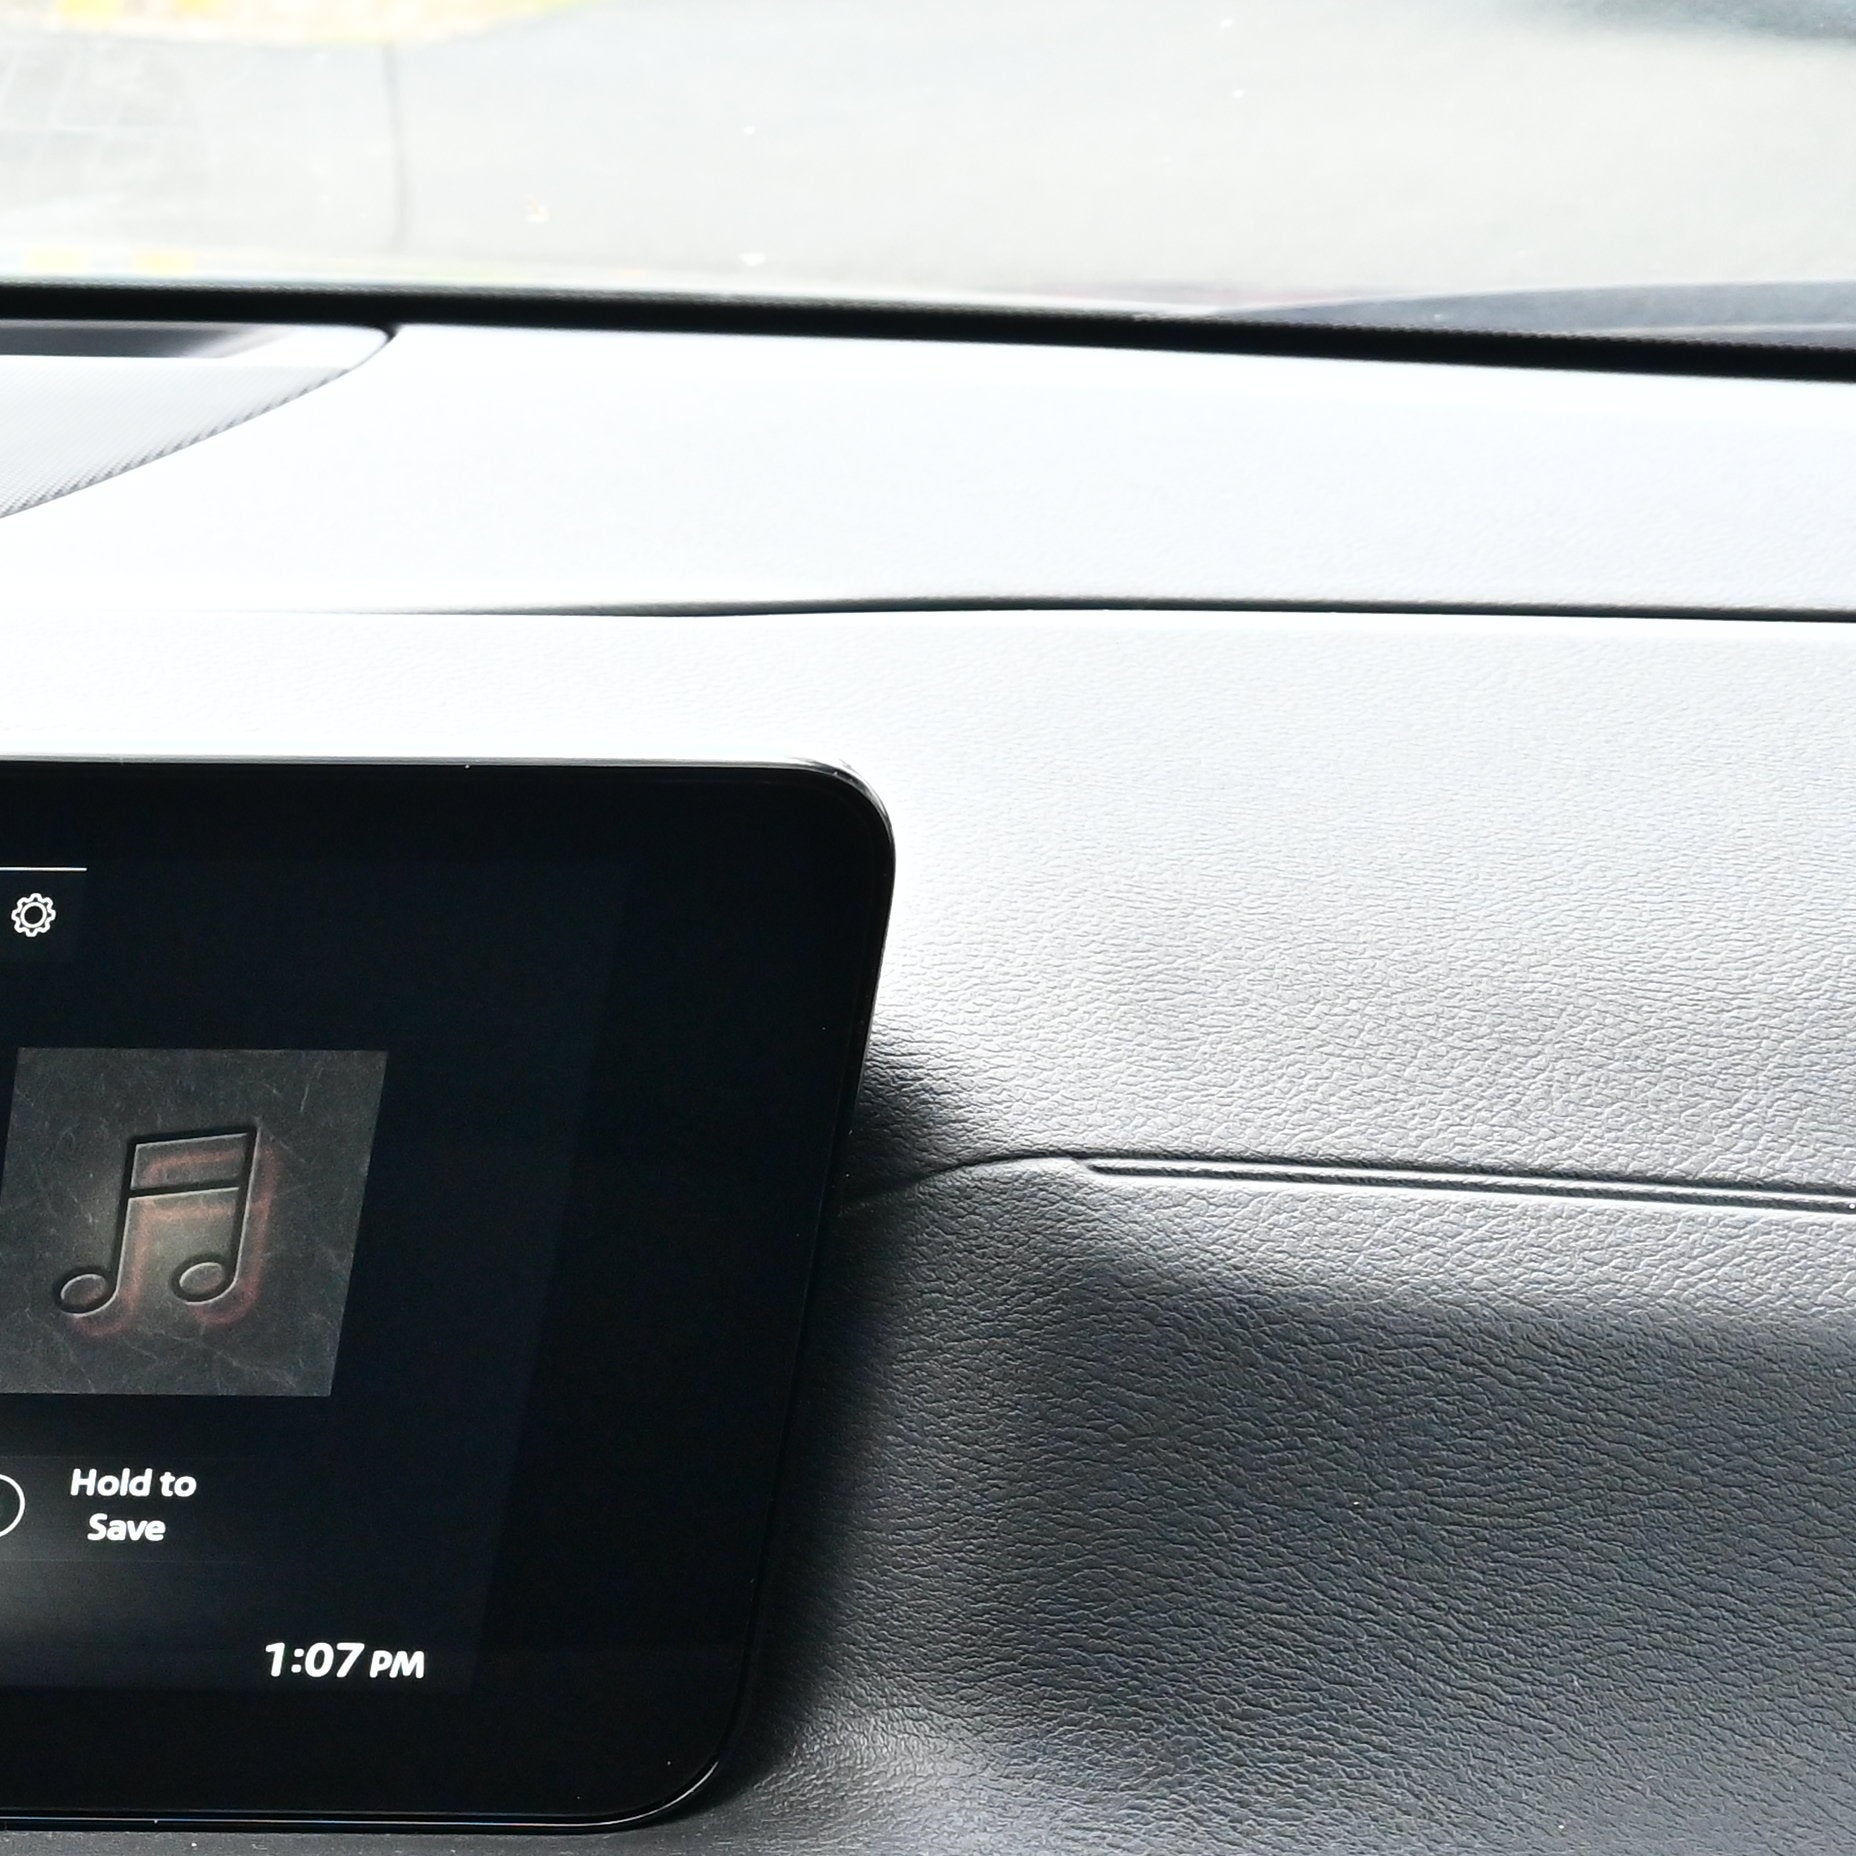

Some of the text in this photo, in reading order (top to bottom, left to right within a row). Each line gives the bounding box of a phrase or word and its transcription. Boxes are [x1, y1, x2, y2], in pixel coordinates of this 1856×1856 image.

[70, 1468, 197, 1498] Hold to
[87, 1513, 166, 1542] Save
[265, 1641, 425, 1679] 1:07 PM
